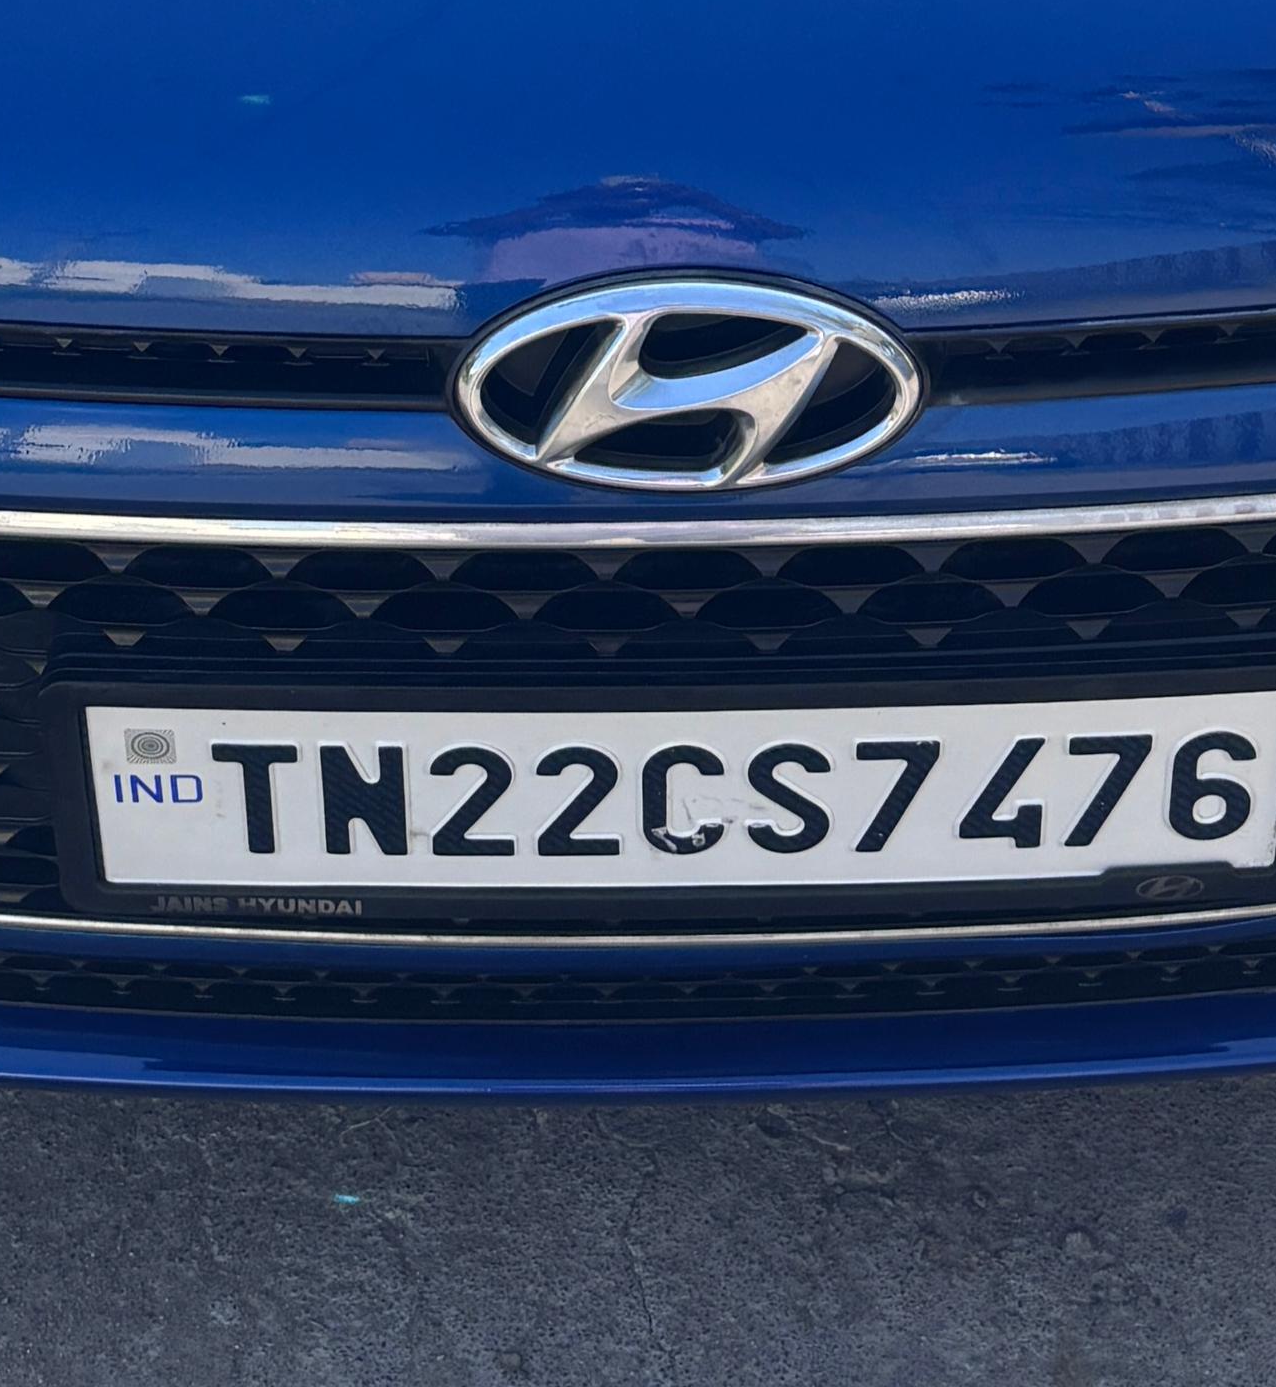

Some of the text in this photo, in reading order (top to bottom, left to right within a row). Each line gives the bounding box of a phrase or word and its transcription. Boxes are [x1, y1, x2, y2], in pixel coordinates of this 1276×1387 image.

[114, 774, 203, 803] IND
[211, 731, 1257, 856] TN22CS7476
[150, 895, 363, 916] JAINS HYUNDAI
